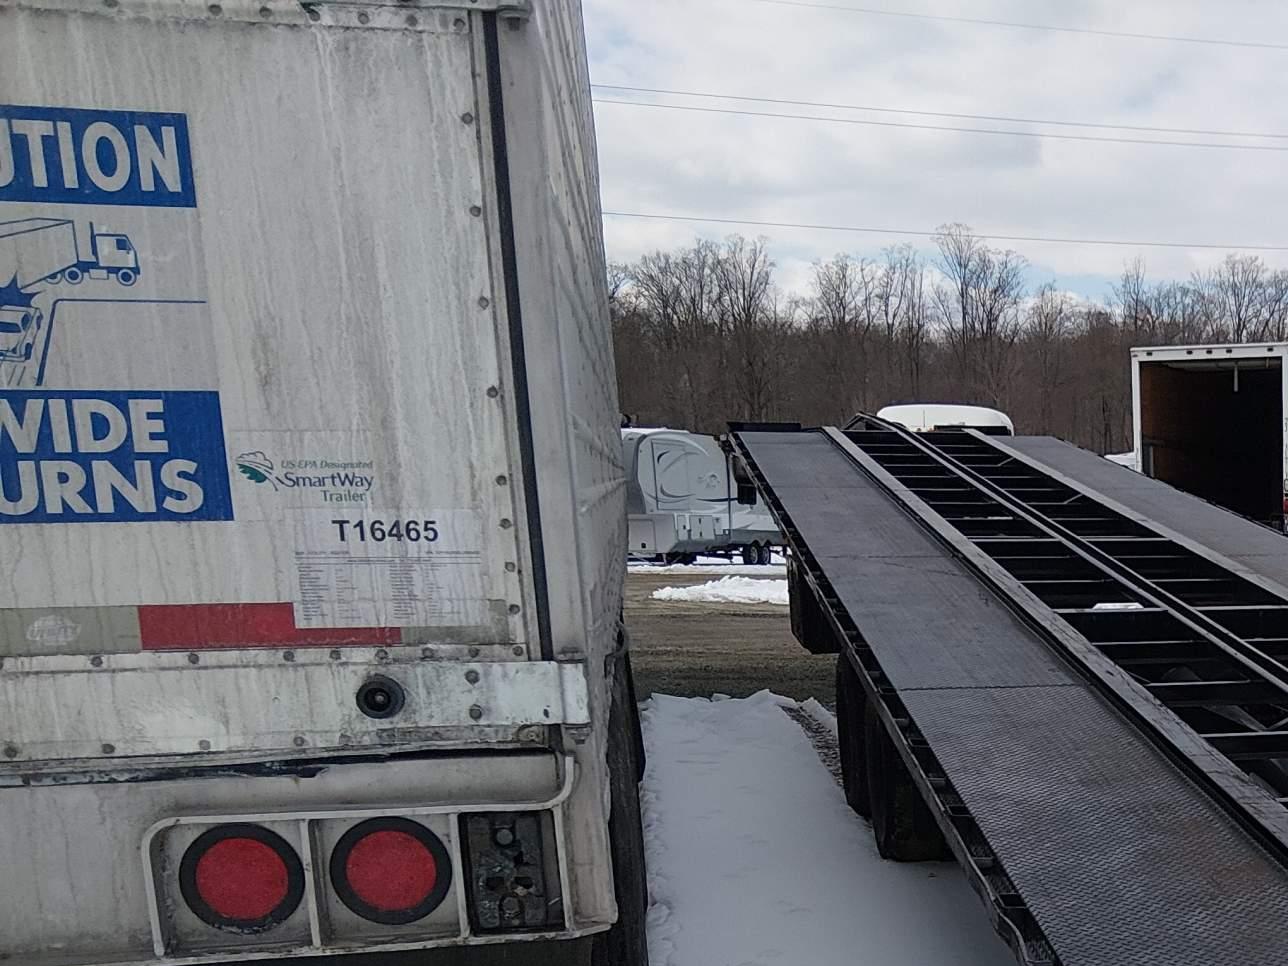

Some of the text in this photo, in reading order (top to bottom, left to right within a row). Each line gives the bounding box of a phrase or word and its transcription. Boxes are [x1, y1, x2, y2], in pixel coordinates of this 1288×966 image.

[298, 460, 318, 469] EPA
[320, 460, 374, 471] Designated
[276, 472, 374, 491] SmartWay
[320, 489, 366, 502] Trailer
[331, 519, 439, 542] T16465
